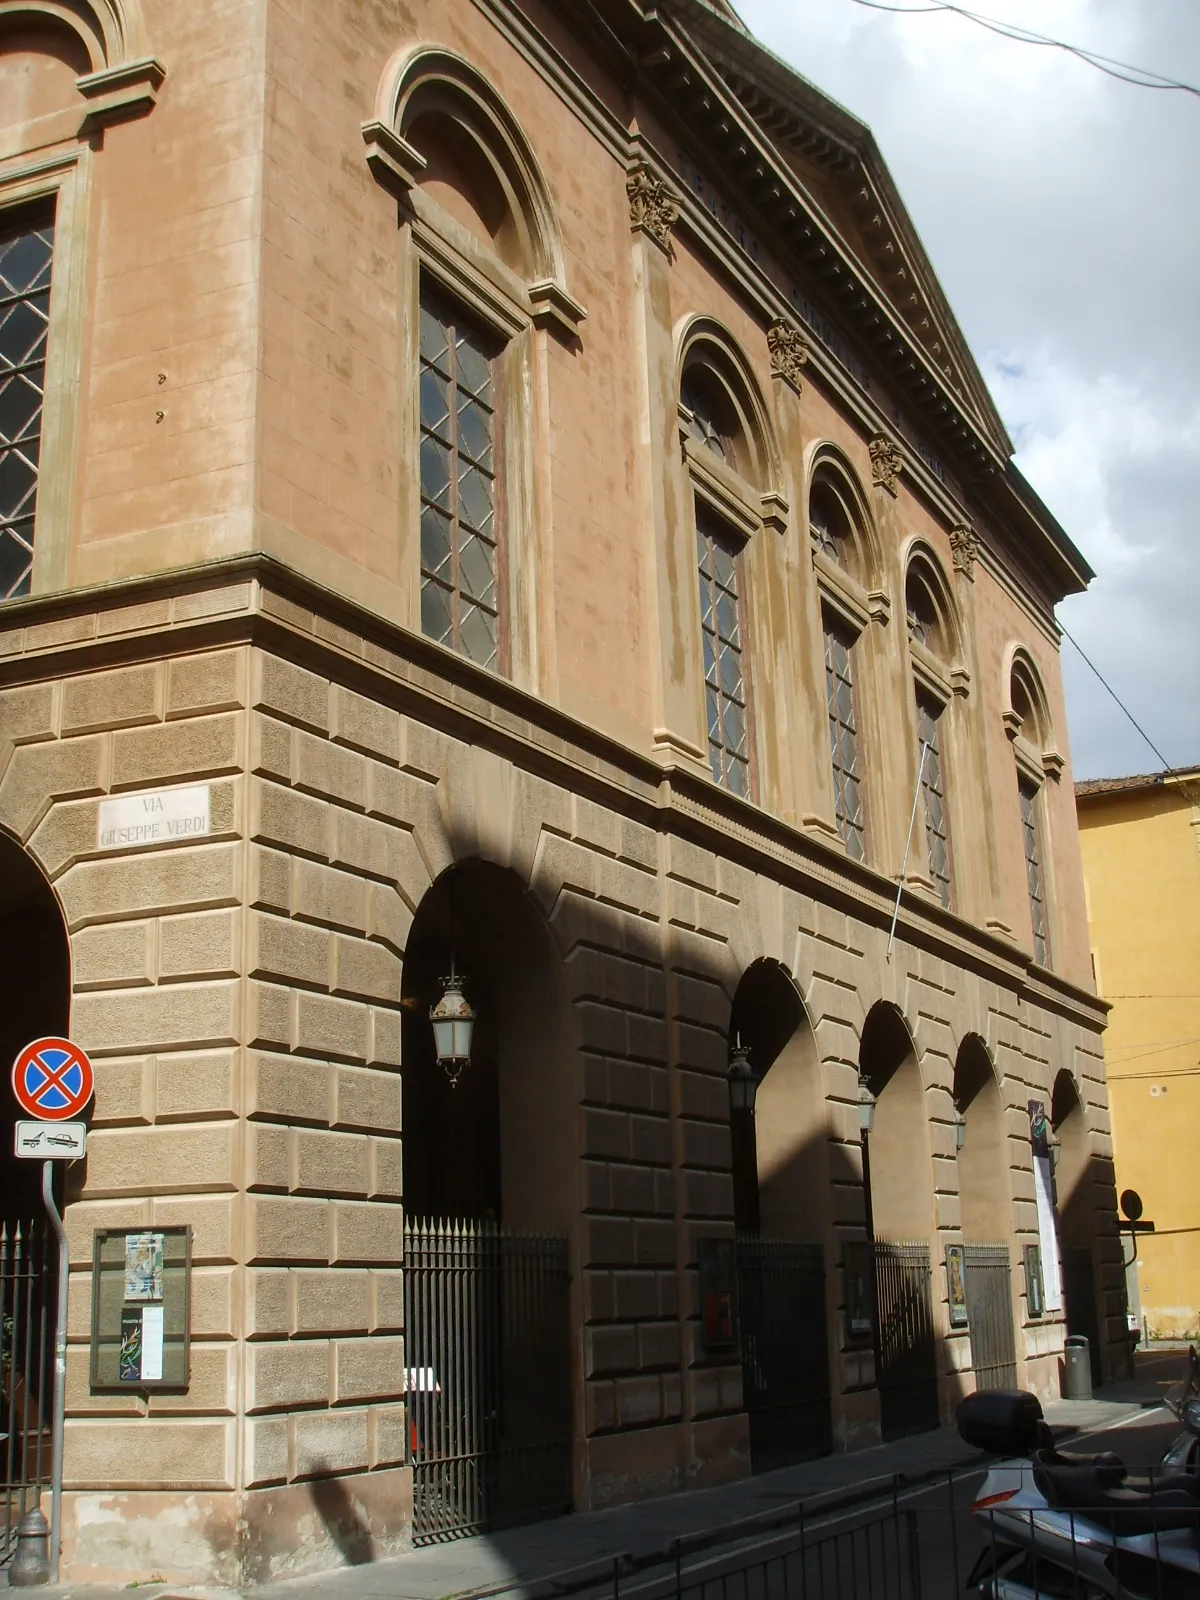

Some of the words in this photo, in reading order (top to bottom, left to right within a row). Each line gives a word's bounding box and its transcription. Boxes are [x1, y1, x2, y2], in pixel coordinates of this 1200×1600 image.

[143, 797, 164, 813] VIA
[101, 822, 160, 846] GIUSEPPE
[167, 816, 205, 835] VERDI
